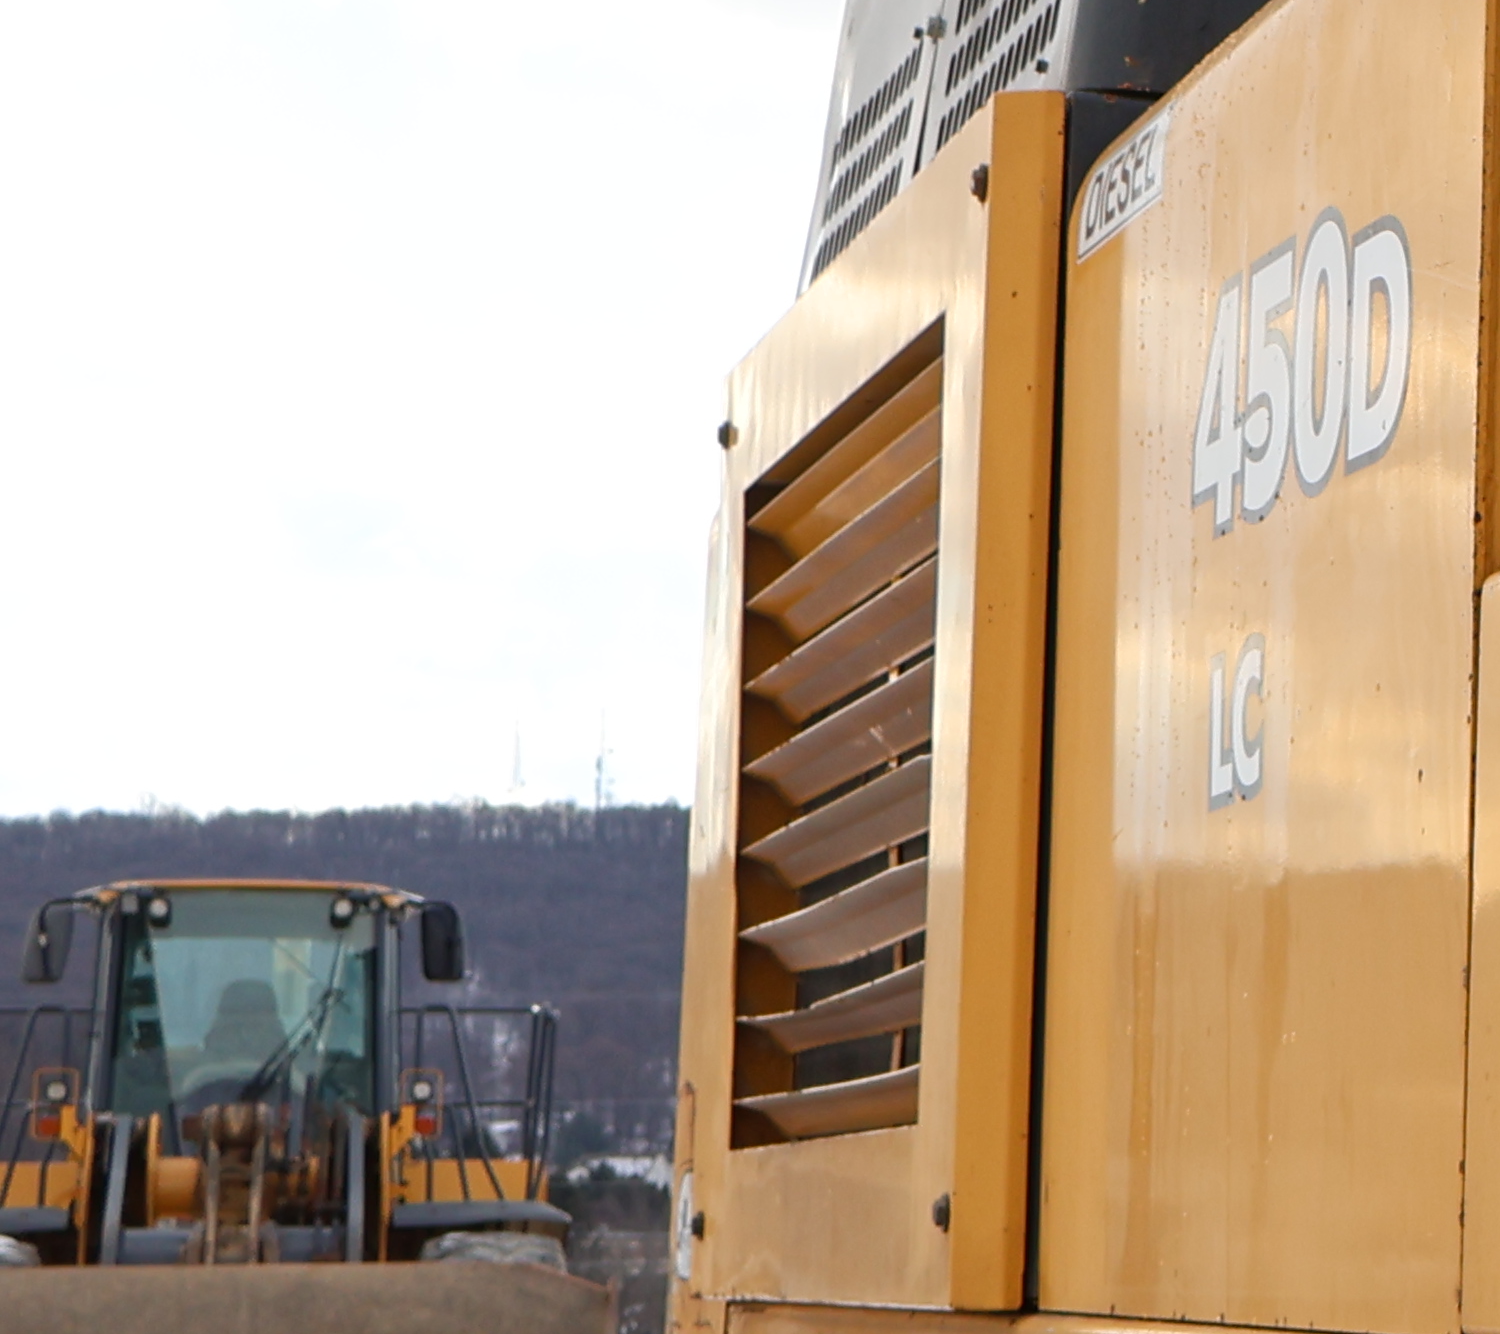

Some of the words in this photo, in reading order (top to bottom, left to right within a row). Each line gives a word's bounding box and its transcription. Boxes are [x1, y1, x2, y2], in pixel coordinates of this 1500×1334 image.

[1085, 124, 1158, 241] DIESEL
[1192, 206, 1413, 539] 450D
[1208, 633, 1266, 811] LC
